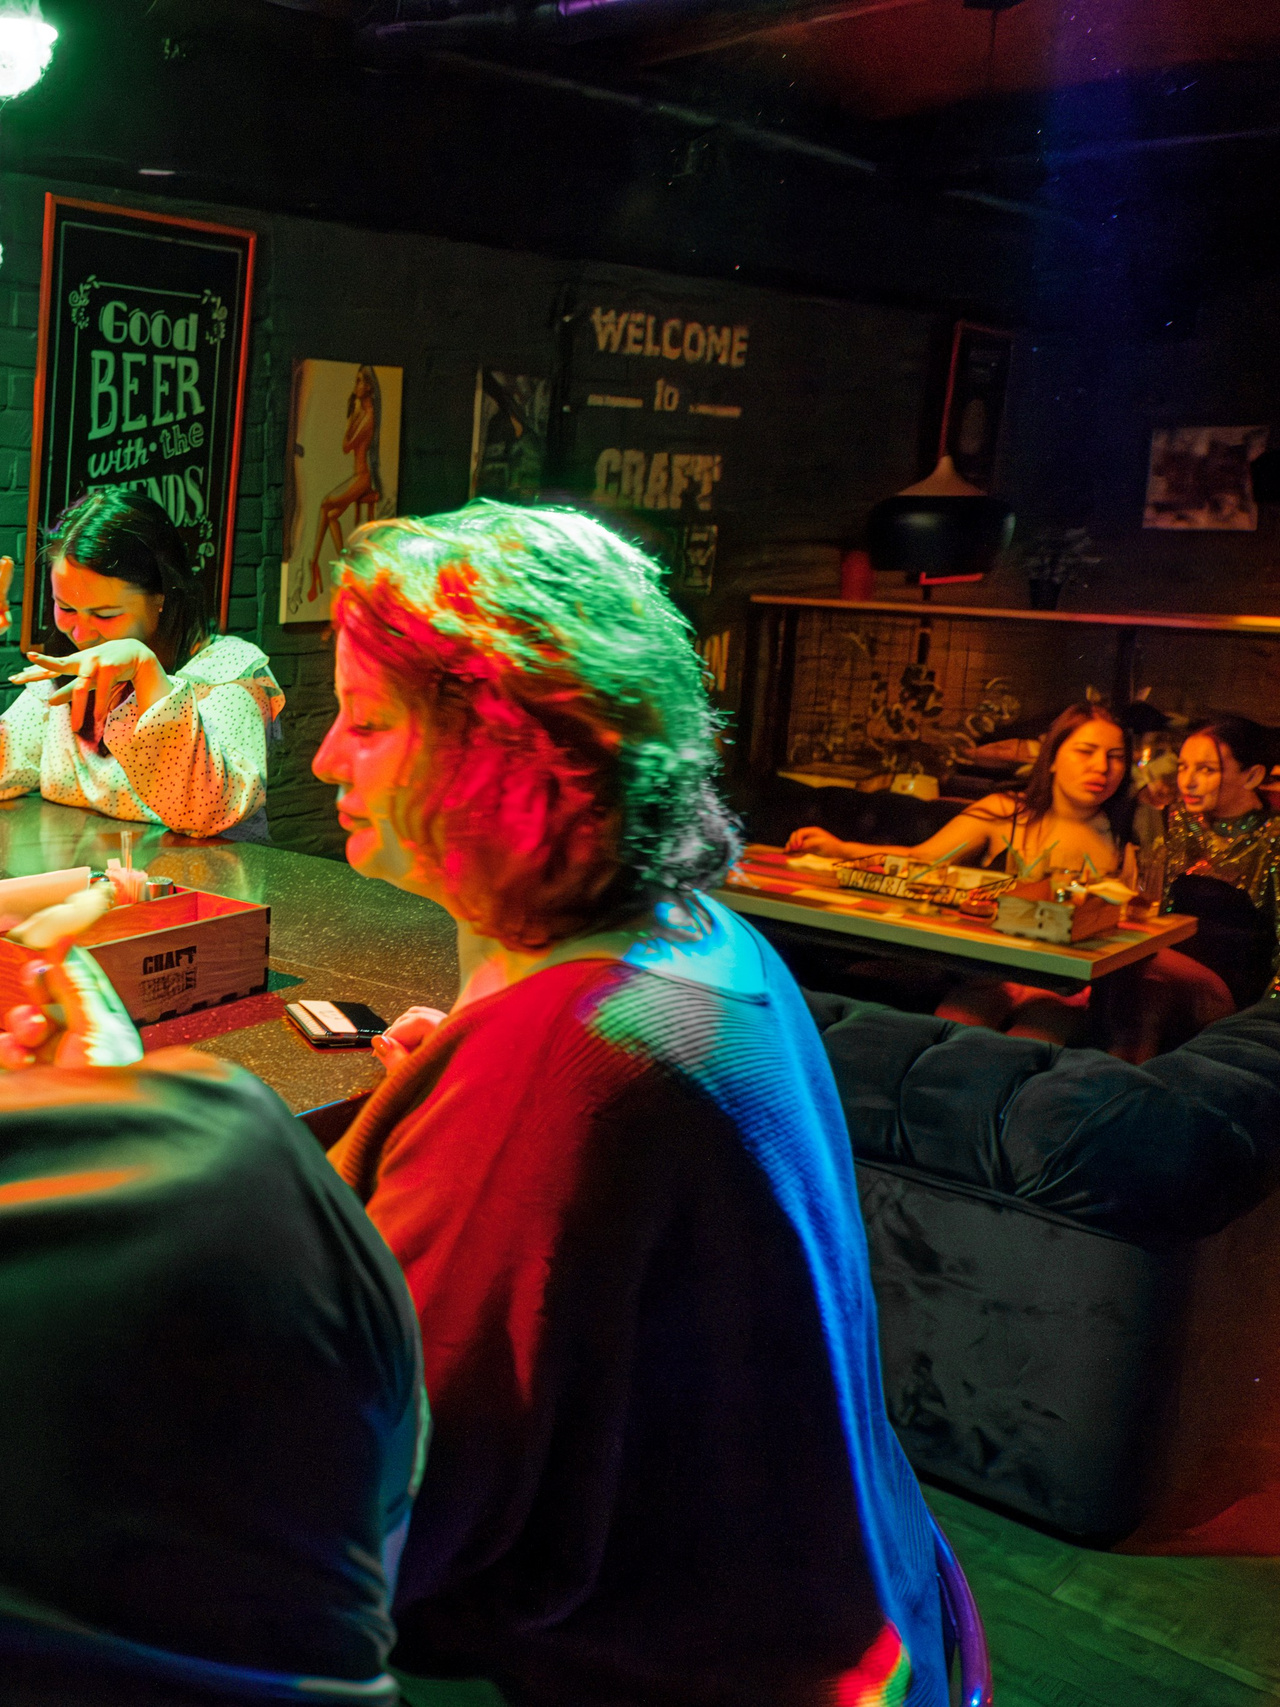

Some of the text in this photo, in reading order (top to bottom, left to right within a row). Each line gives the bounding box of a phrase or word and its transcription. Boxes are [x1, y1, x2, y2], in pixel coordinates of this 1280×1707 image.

[590, 306, 750, 368] WELCOME
[87, 350, 205, 440] BEER
[88, 421, 205, 478] with the
[594, 447, 722, 511] CRAFT
[142, 945, 197, 975] CRAFT
